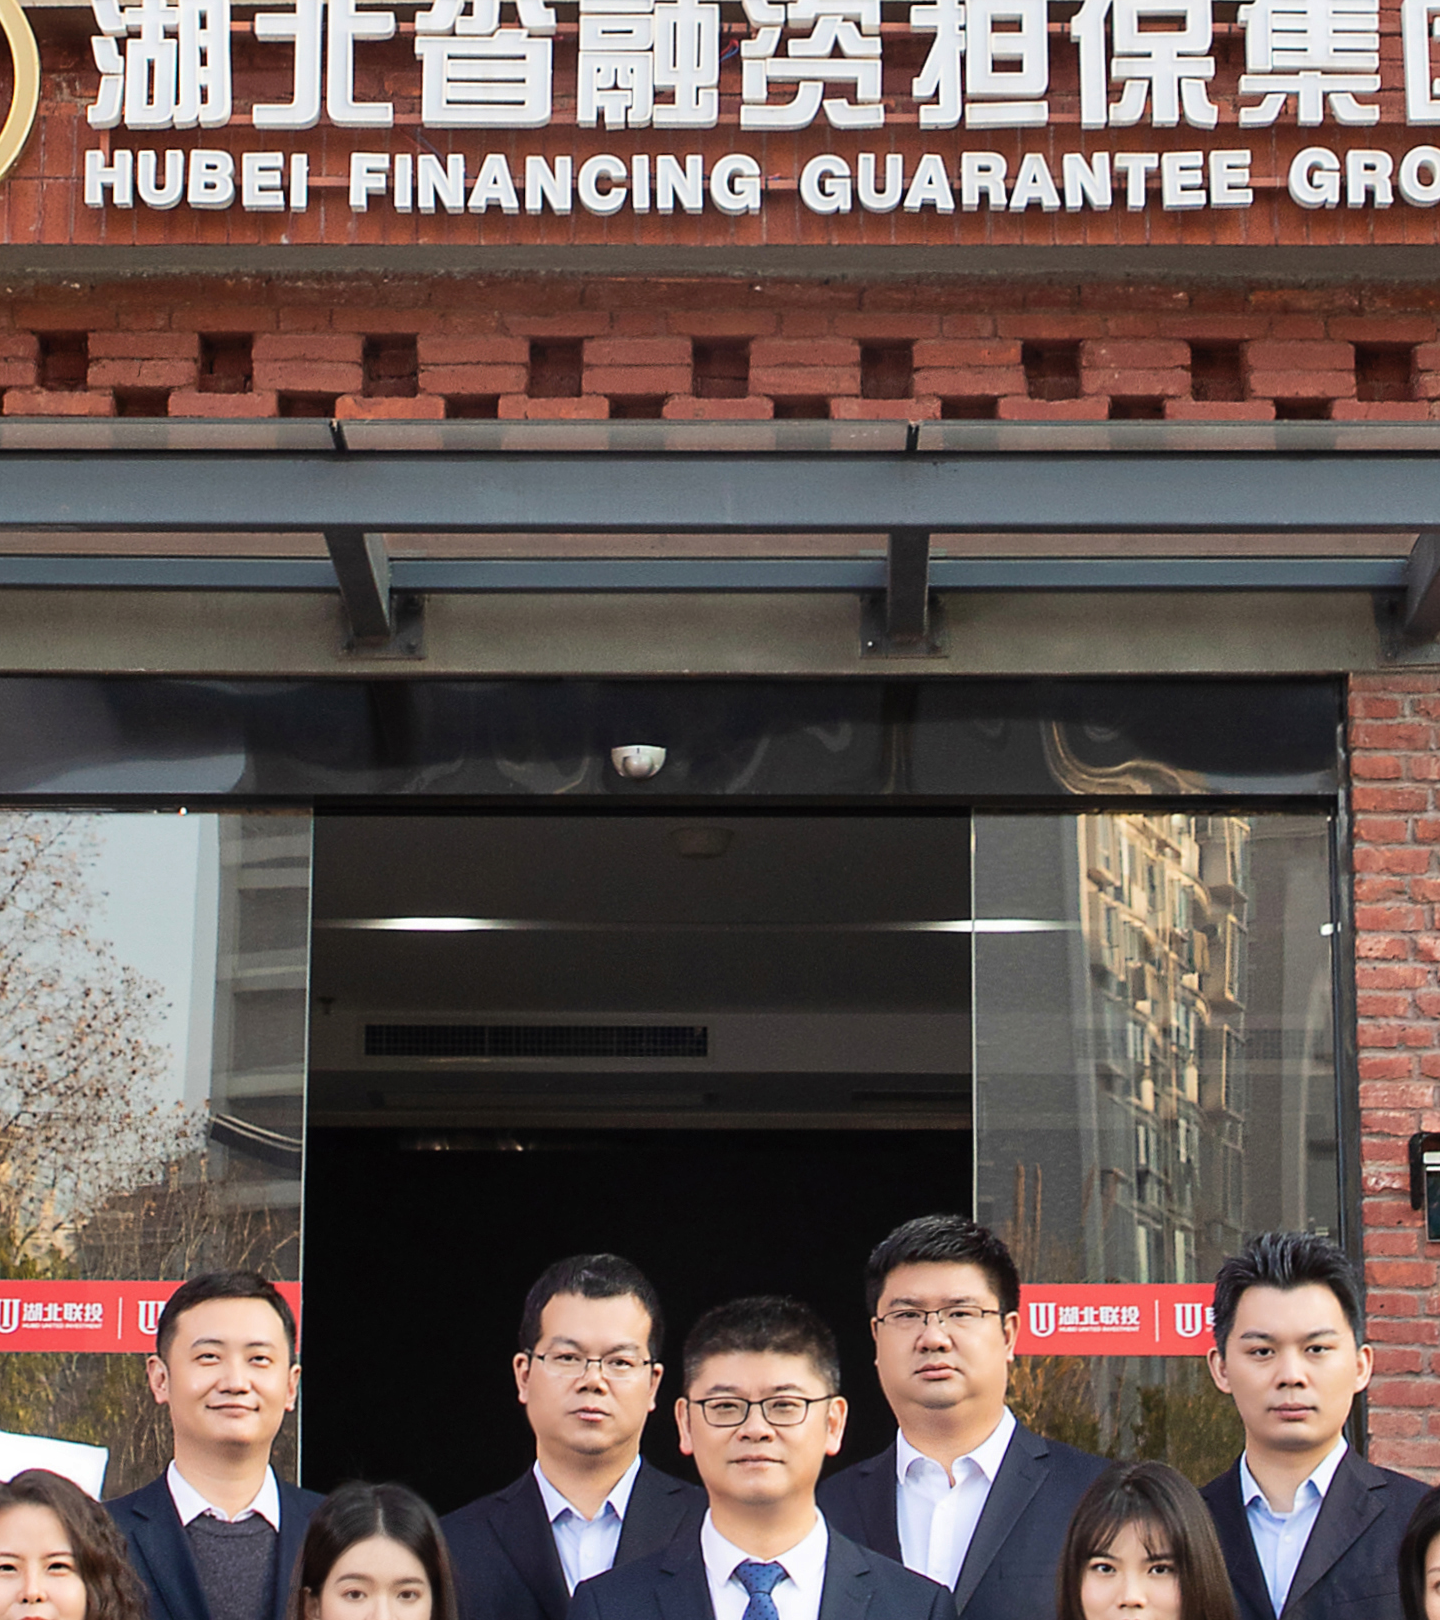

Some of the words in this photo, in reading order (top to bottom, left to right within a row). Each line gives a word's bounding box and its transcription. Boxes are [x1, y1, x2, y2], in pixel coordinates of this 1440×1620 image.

[83, 148, 309, 213] HUBEI
[348, 152, 762, 216] FINANCING
[798, 149, 1254, 215] GUARANTEE
[22, 1302, 103, 1322] 湖北联投
[1058, 1306, 1140, 1326] 湖北联投
